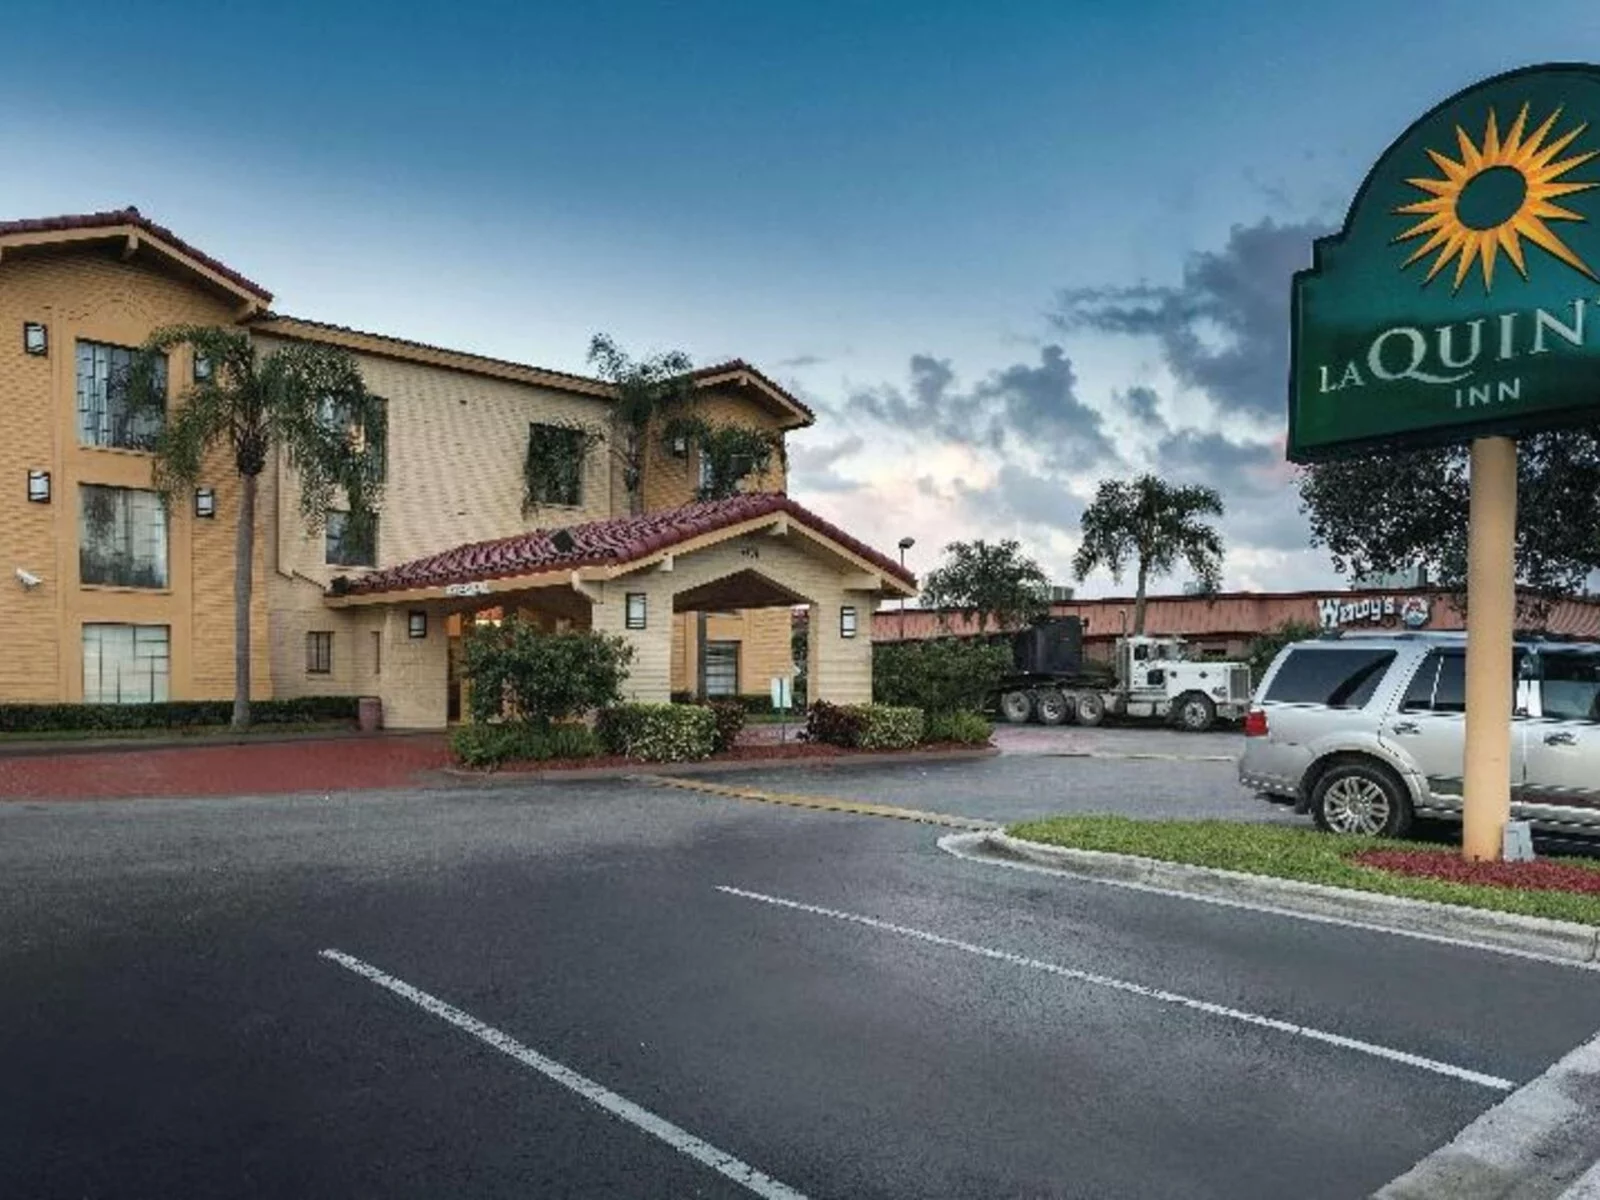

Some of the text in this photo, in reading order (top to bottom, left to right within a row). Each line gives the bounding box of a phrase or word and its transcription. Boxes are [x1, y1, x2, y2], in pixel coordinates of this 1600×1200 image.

[1319, 298, 1600, 393] LA QUIN
[1455, 378, 1521, 408] INN
